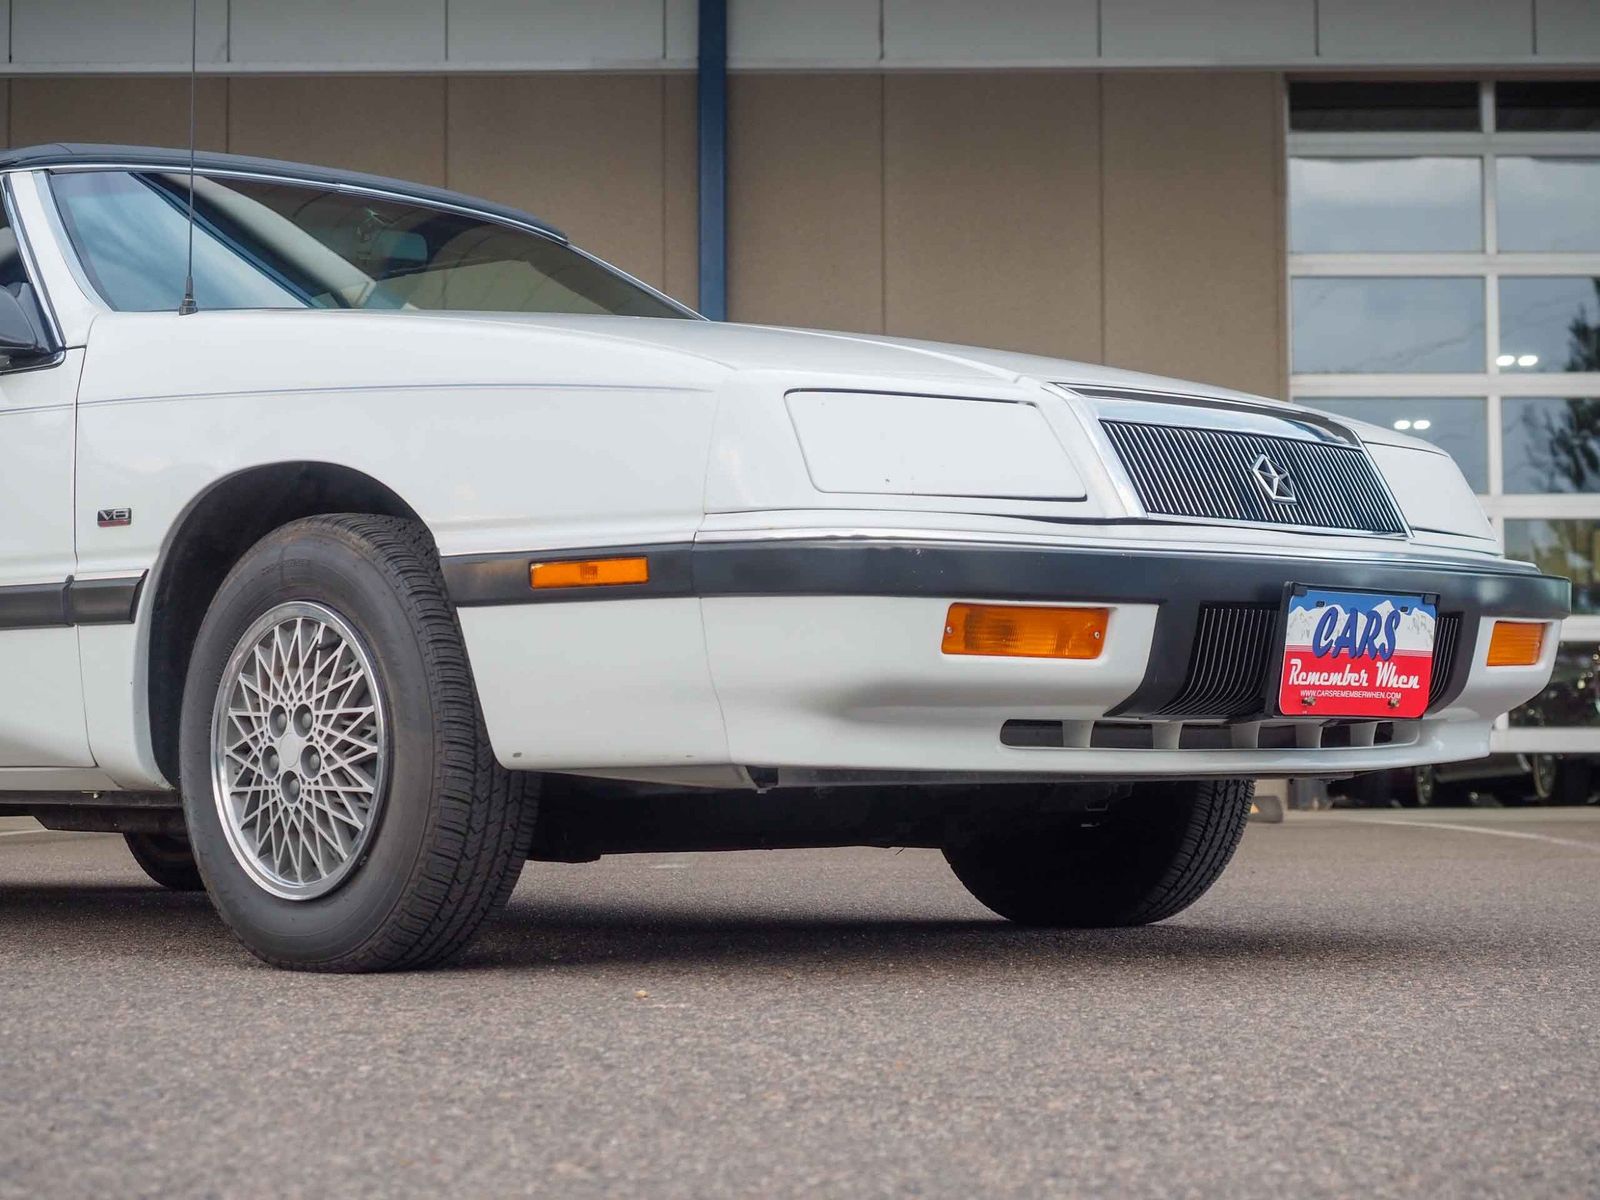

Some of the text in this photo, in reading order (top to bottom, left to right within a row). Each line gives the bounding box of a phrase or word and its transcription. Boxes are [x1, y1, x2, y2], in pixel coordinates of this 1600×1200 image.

[99, 508, 129, 521] V6
[1312, 606, 1401, 661] CARS
[1288, 658, 1420, 689] Remember When
[1300, 689, 1402, 700] WWW.CARSREMEMBERWHEN.COM
